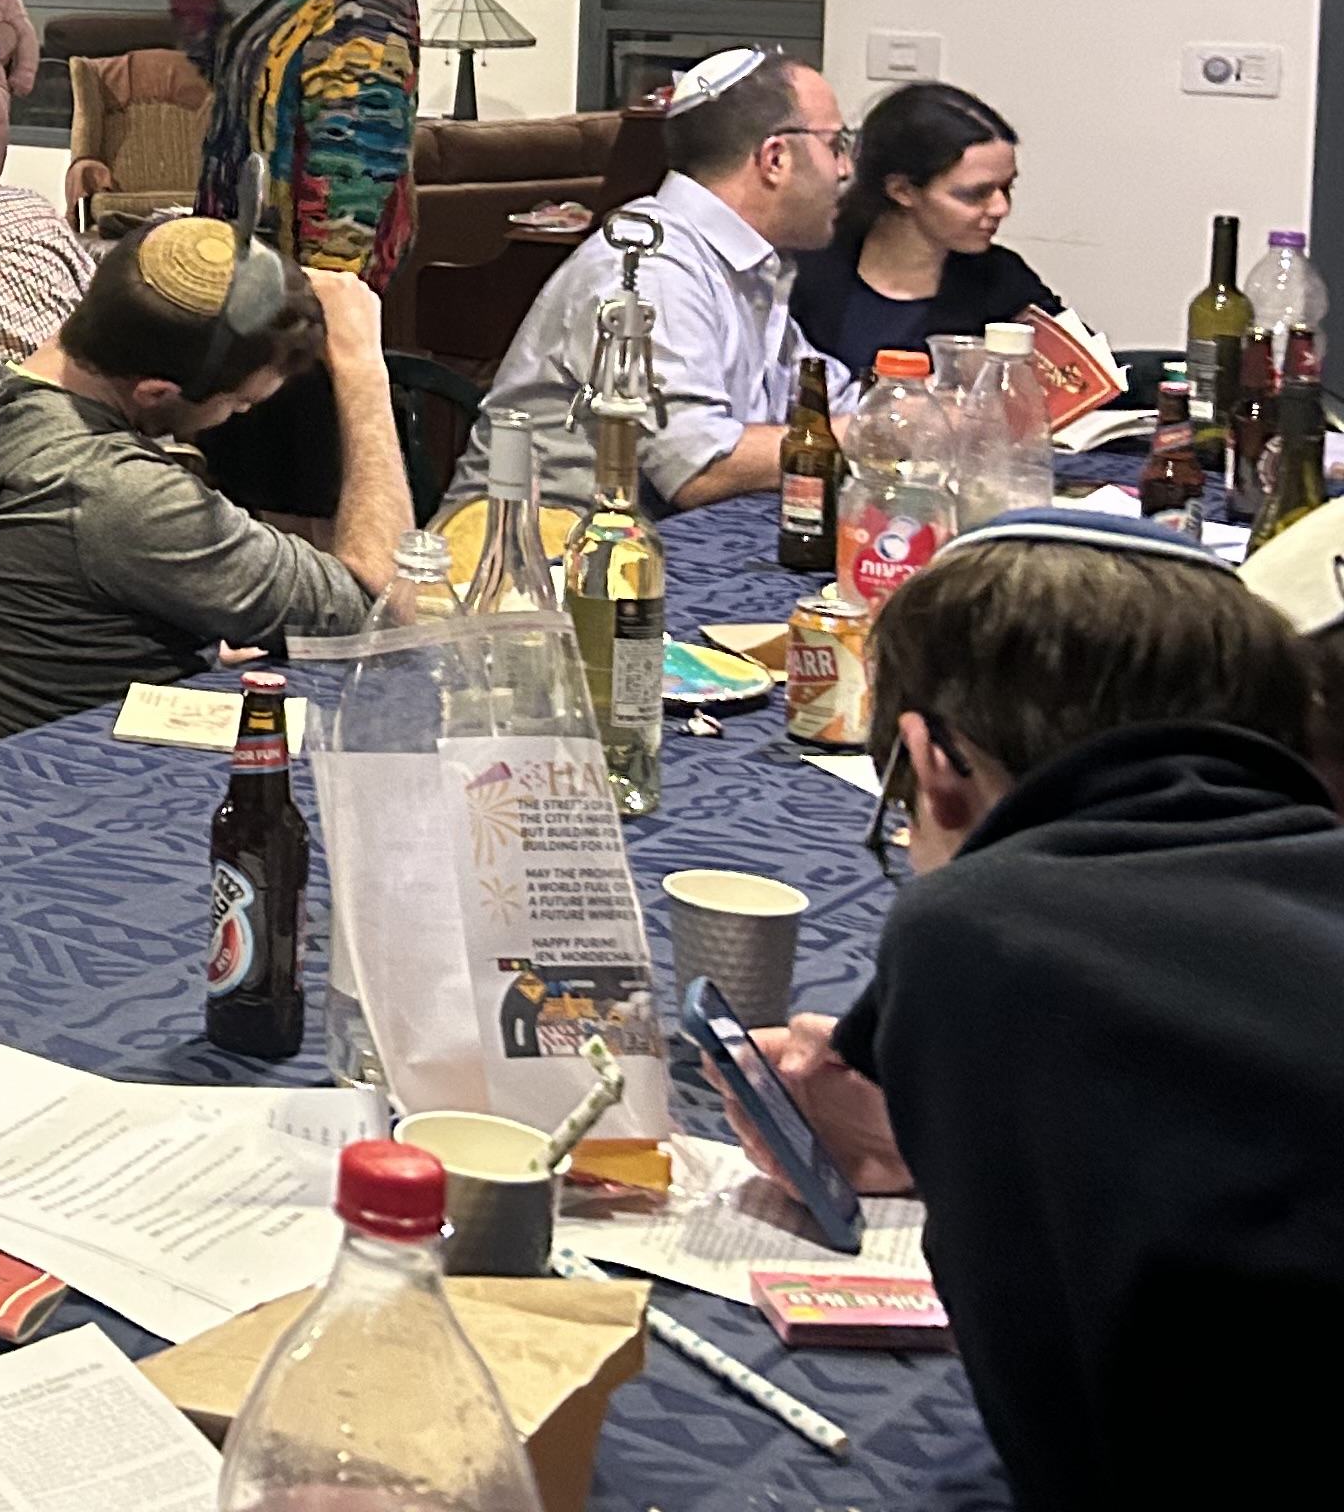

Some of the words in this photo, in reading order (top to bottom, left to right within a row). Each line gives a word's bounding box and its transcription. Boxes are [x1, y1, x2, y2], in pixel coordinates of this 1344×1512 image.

[255, 748, 281, 760] FUN
[518, 799, 540, 810] THE
[519, 813, 542, 824] THE
[544, 813, 570, 824] CITY
[522, 840, 578, 852] BUILDING
[525, 868, 551, 878] MAY
[553, 868, 576, 879] THE
[527, 882, 536, 892] A
[537, 882, 581, 892] WORLD
[584, 882, 611, 892] FULL
[528, 896, 537, 906] A
[539, 896, 584, 906] FUTURE
[529, 910, 538, 920] A
[540, 910, 584, 920] FUTURE
[532, 937, 570, 948] HAPPY
